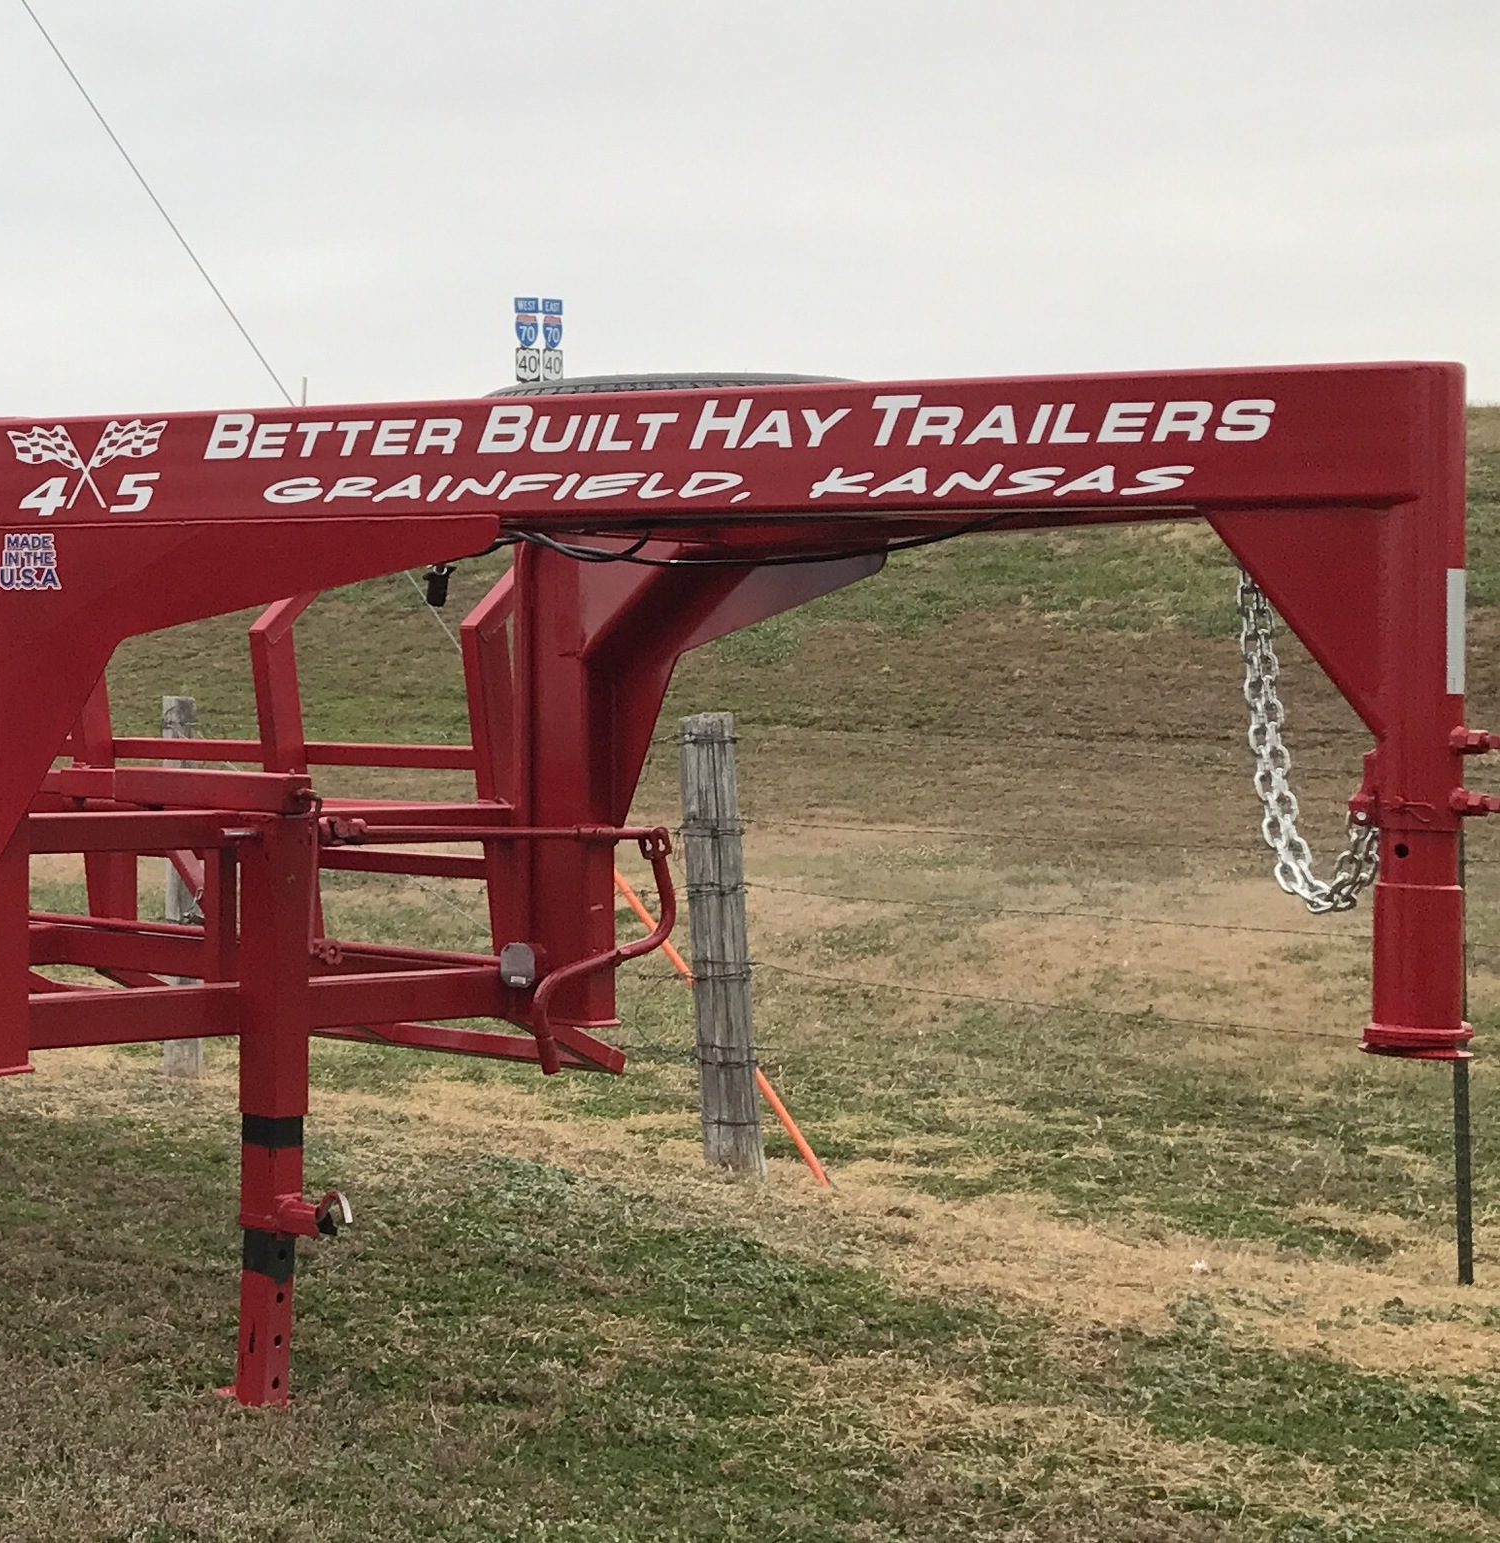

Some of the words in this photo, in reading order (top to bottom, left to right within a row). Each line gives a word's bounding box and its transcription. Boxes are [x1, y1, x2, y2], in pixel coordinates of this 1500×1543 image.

[517, 300, 536, 311] WEST
[545, 301, 560, 312] EAST
[519, 326, 535, 342] 70
[546, 327, 560, 343] 70
[519, 356, 537, 373] 40
[545, 357, 561, 374] 40
[204, 413, 463, 460] BETTER
[477, 406, 680, 454] BUILT
[690, 399, 853, 449] HAY
[872, 395, 1275, 445] TRAILERS
[263, 470, 751, 504] GRAINFIELD,
[809, 464, 1195, 499] KANSAS
[18, 477, 68, 516] 4
[109, 473, 161, 513] 5
[6, 535, 53, 551] MADE
[4, 551, 20, 567] IN
[23, 551, 56, 567] THE
